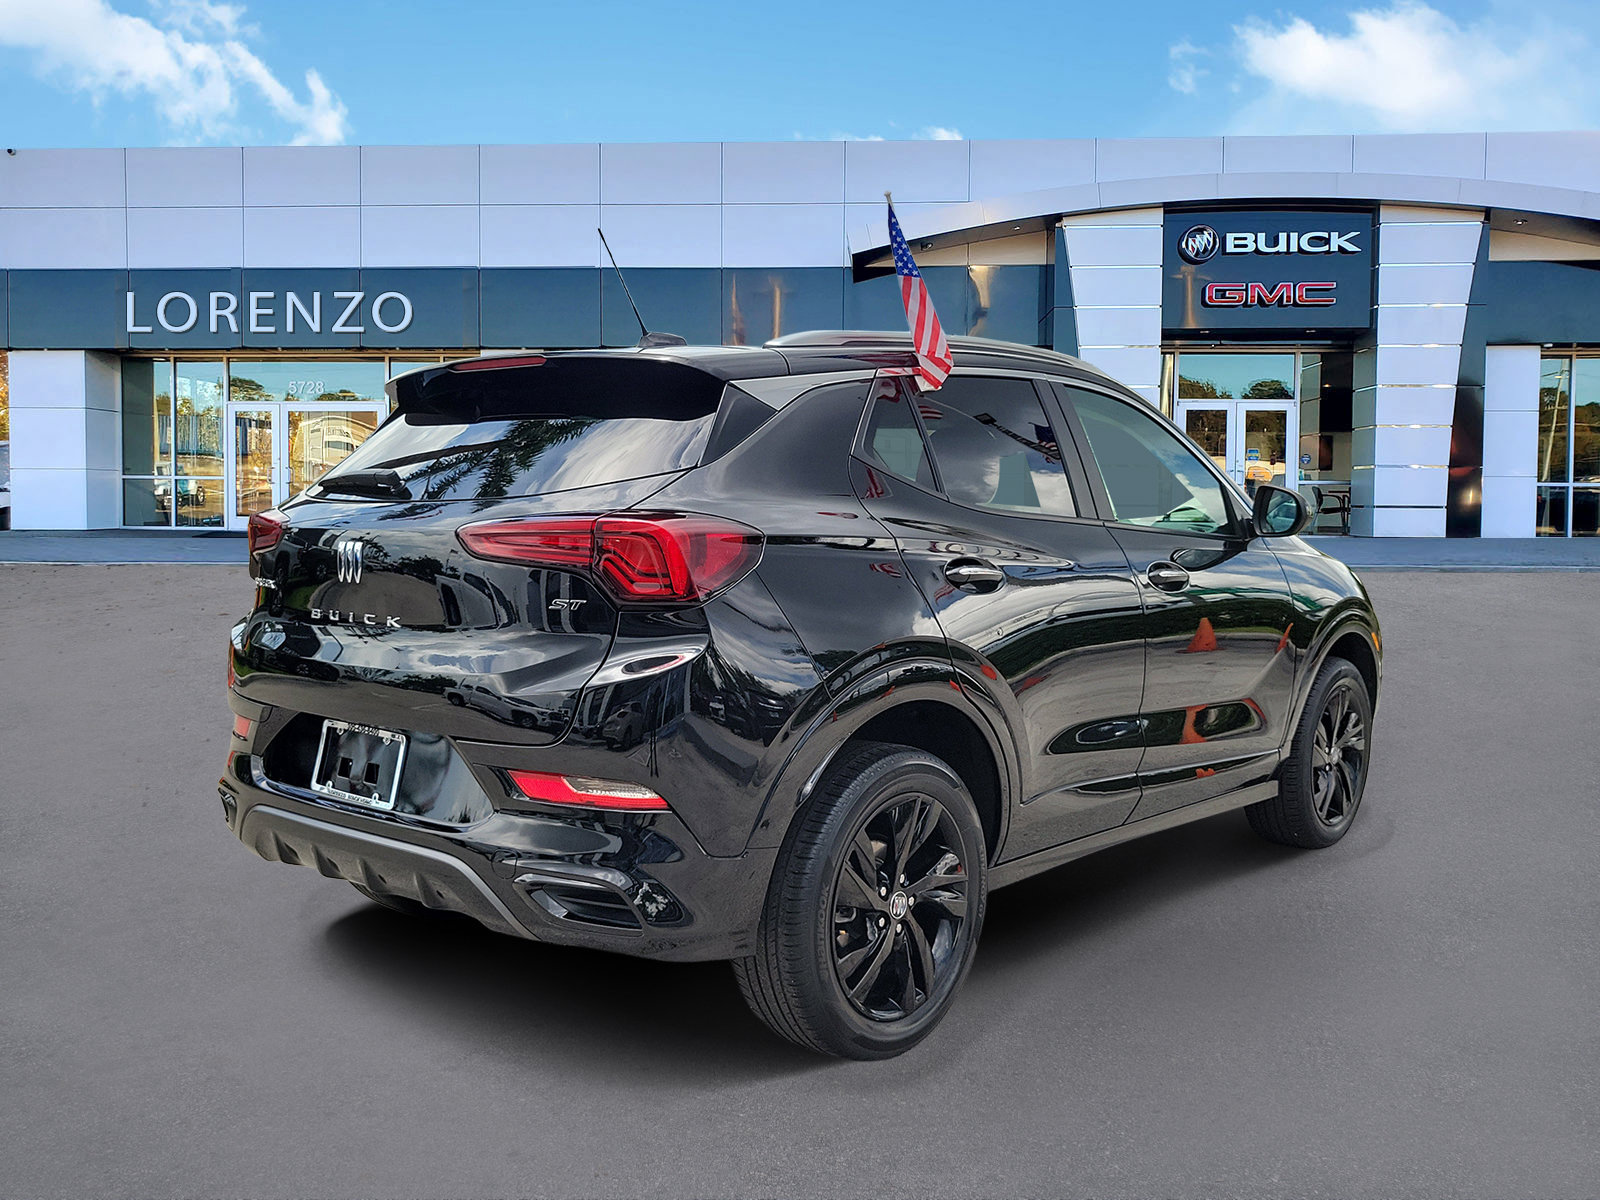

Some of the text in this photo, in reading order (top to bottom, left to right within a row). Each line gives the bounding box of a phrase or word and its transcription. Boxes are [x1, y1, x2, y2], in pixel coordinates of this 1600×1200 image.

[1225, 231, 1362, 253] BUICK
[1205, 282, 1337, 305] GMC
[126, 290, 414, 333] LORENZO
[288, 381, 325, 395] 5728
[548, 598, 587, 611] ST
[311, 608, 402, 628] BUICK
